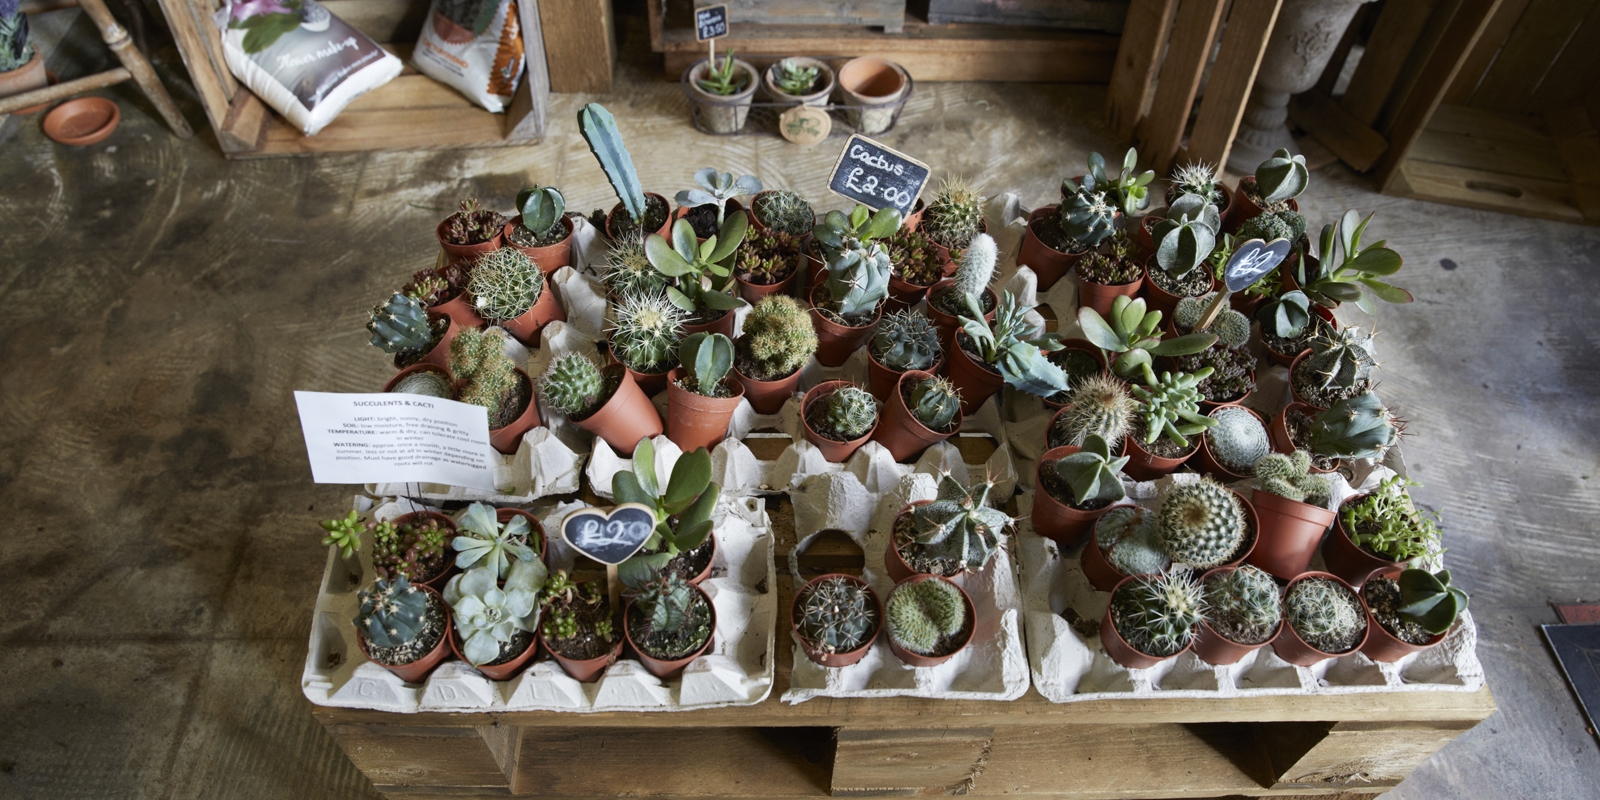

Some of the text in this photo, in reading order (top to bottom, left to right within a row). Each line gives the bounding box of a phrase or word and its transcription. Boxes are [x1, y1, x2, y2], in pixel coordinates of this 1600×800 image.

[850, 144, 904, 176] Cactus
[1230, 248, 1274, 277] £2
[420, 423, 446, 432] draining
[434, 419, 458, 427] position
[432, 431, 456, 440] tolerate
[444, 451, 475, 462] depending
[450, 459, 487, 470] waterlogged
